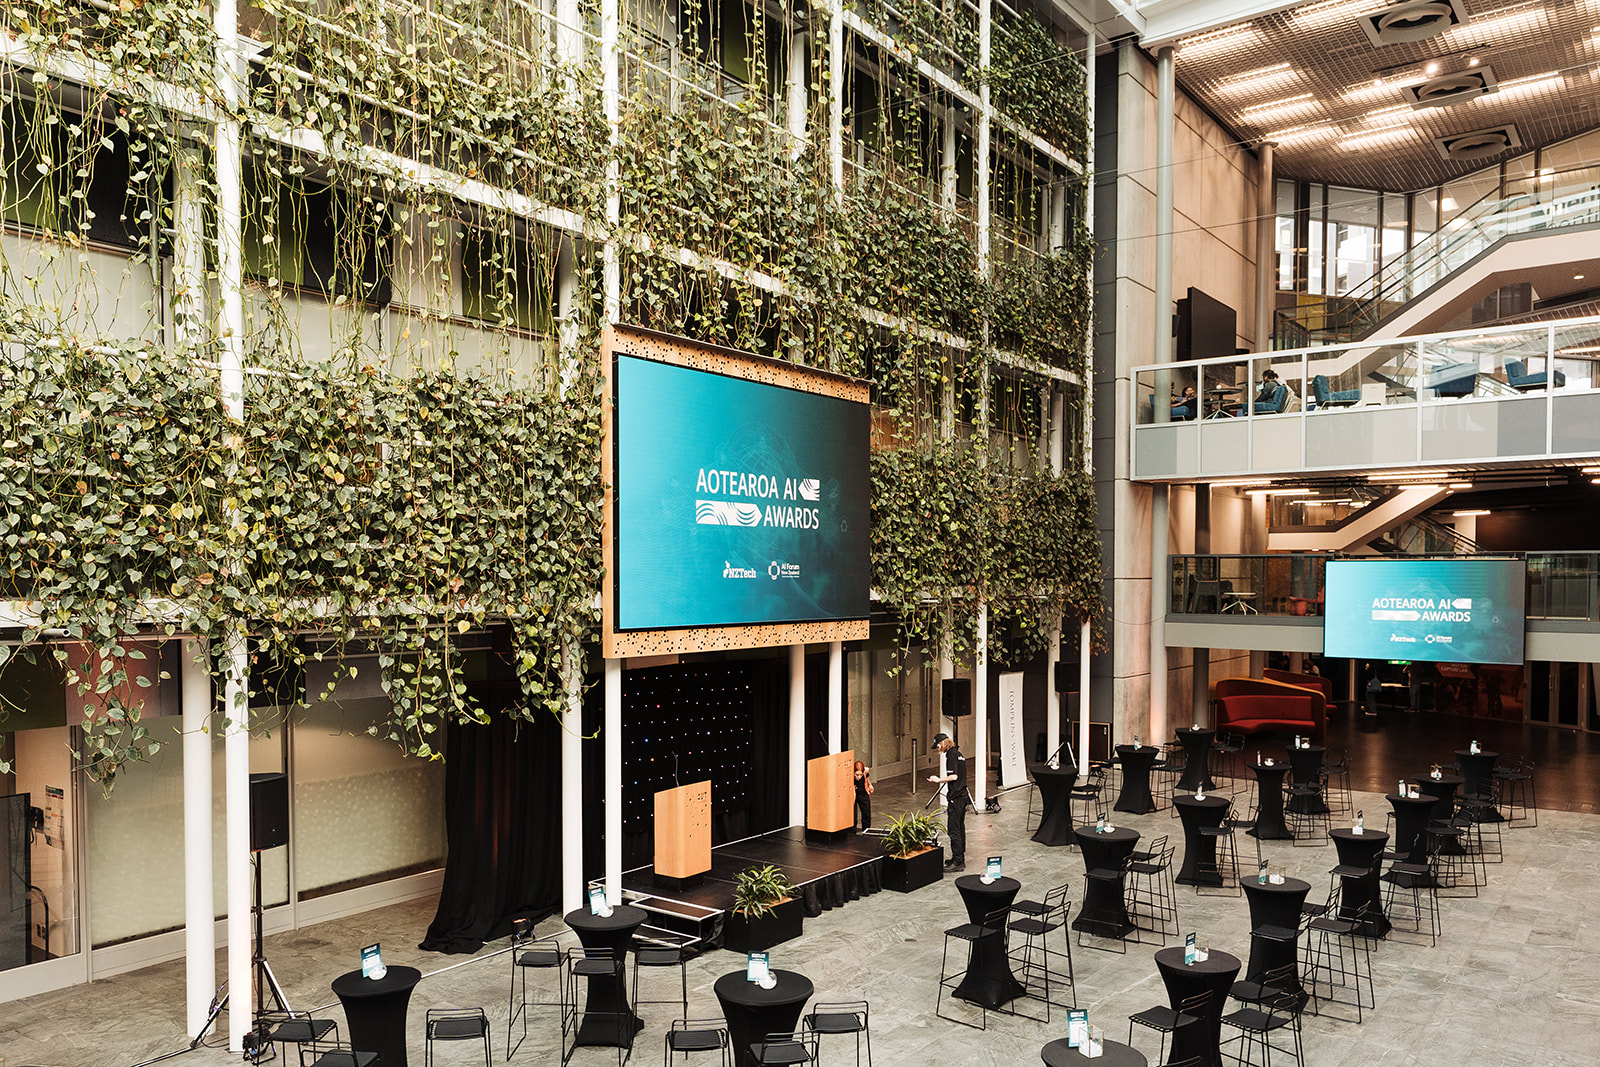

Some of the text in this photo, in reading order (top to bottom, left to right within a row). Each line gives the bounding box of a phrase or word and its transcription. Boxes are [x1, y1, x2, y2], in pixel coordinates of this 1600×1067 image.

[695, 468, 797, 501] AOTEAROA AI
[763, 505, 820, 530] AWARDS
[728, 568, 757, 579] NZTech
[1372, 597, 1451, 609] AOTEAROA AI
[1421, 611, 1471, 622] AWARDS
